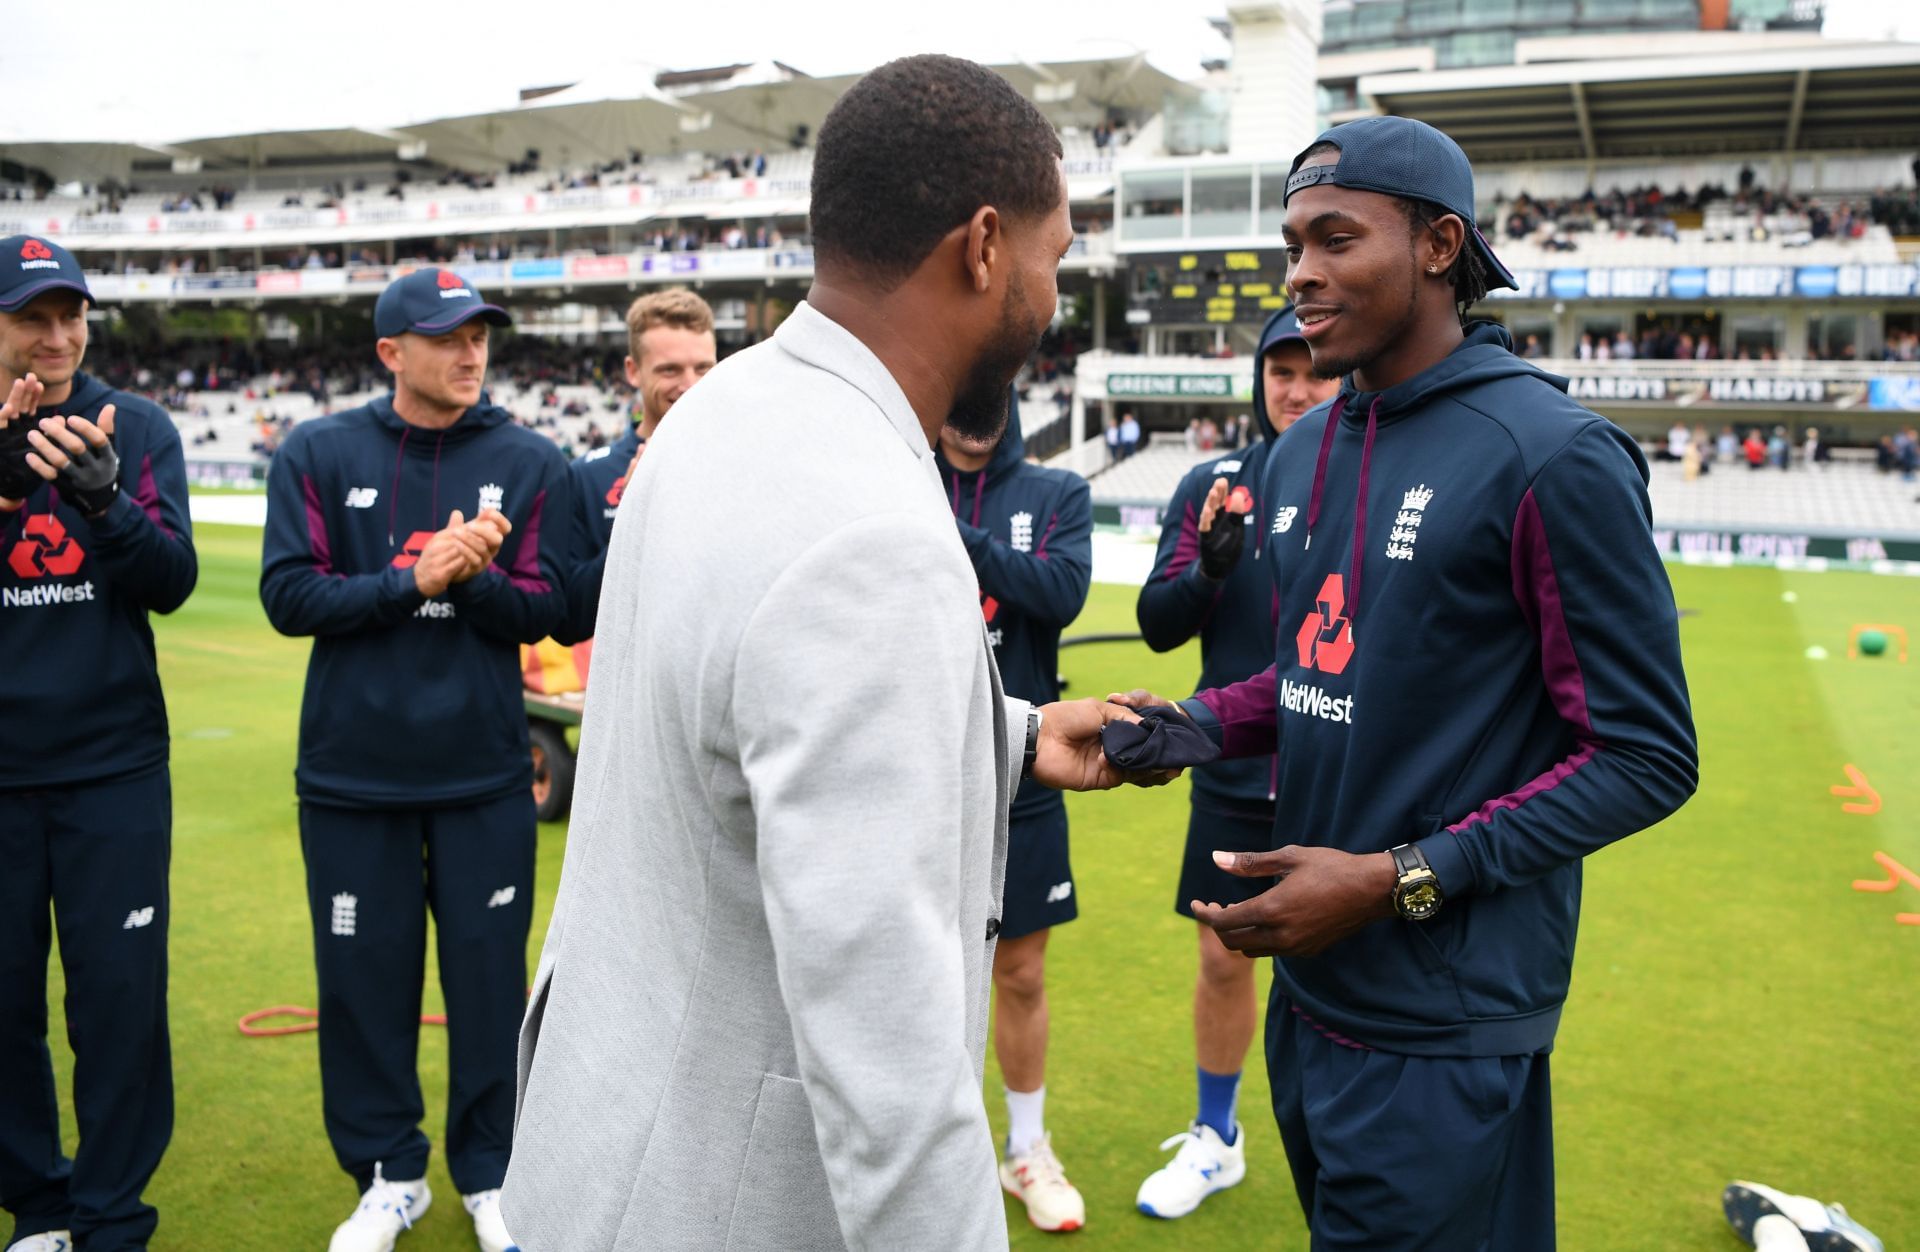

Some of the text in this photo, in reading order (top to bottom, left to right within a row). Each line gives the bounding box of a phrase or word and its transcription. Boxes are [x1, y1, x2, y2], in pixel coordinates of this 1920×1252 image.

[1108, 375, 1228, 395] GREENE KING
[1709, 378, 1824, 401] HARDYS
[2, 580, 95, 607] NatWest
[1280, 678, 1354, 724] NatWest
